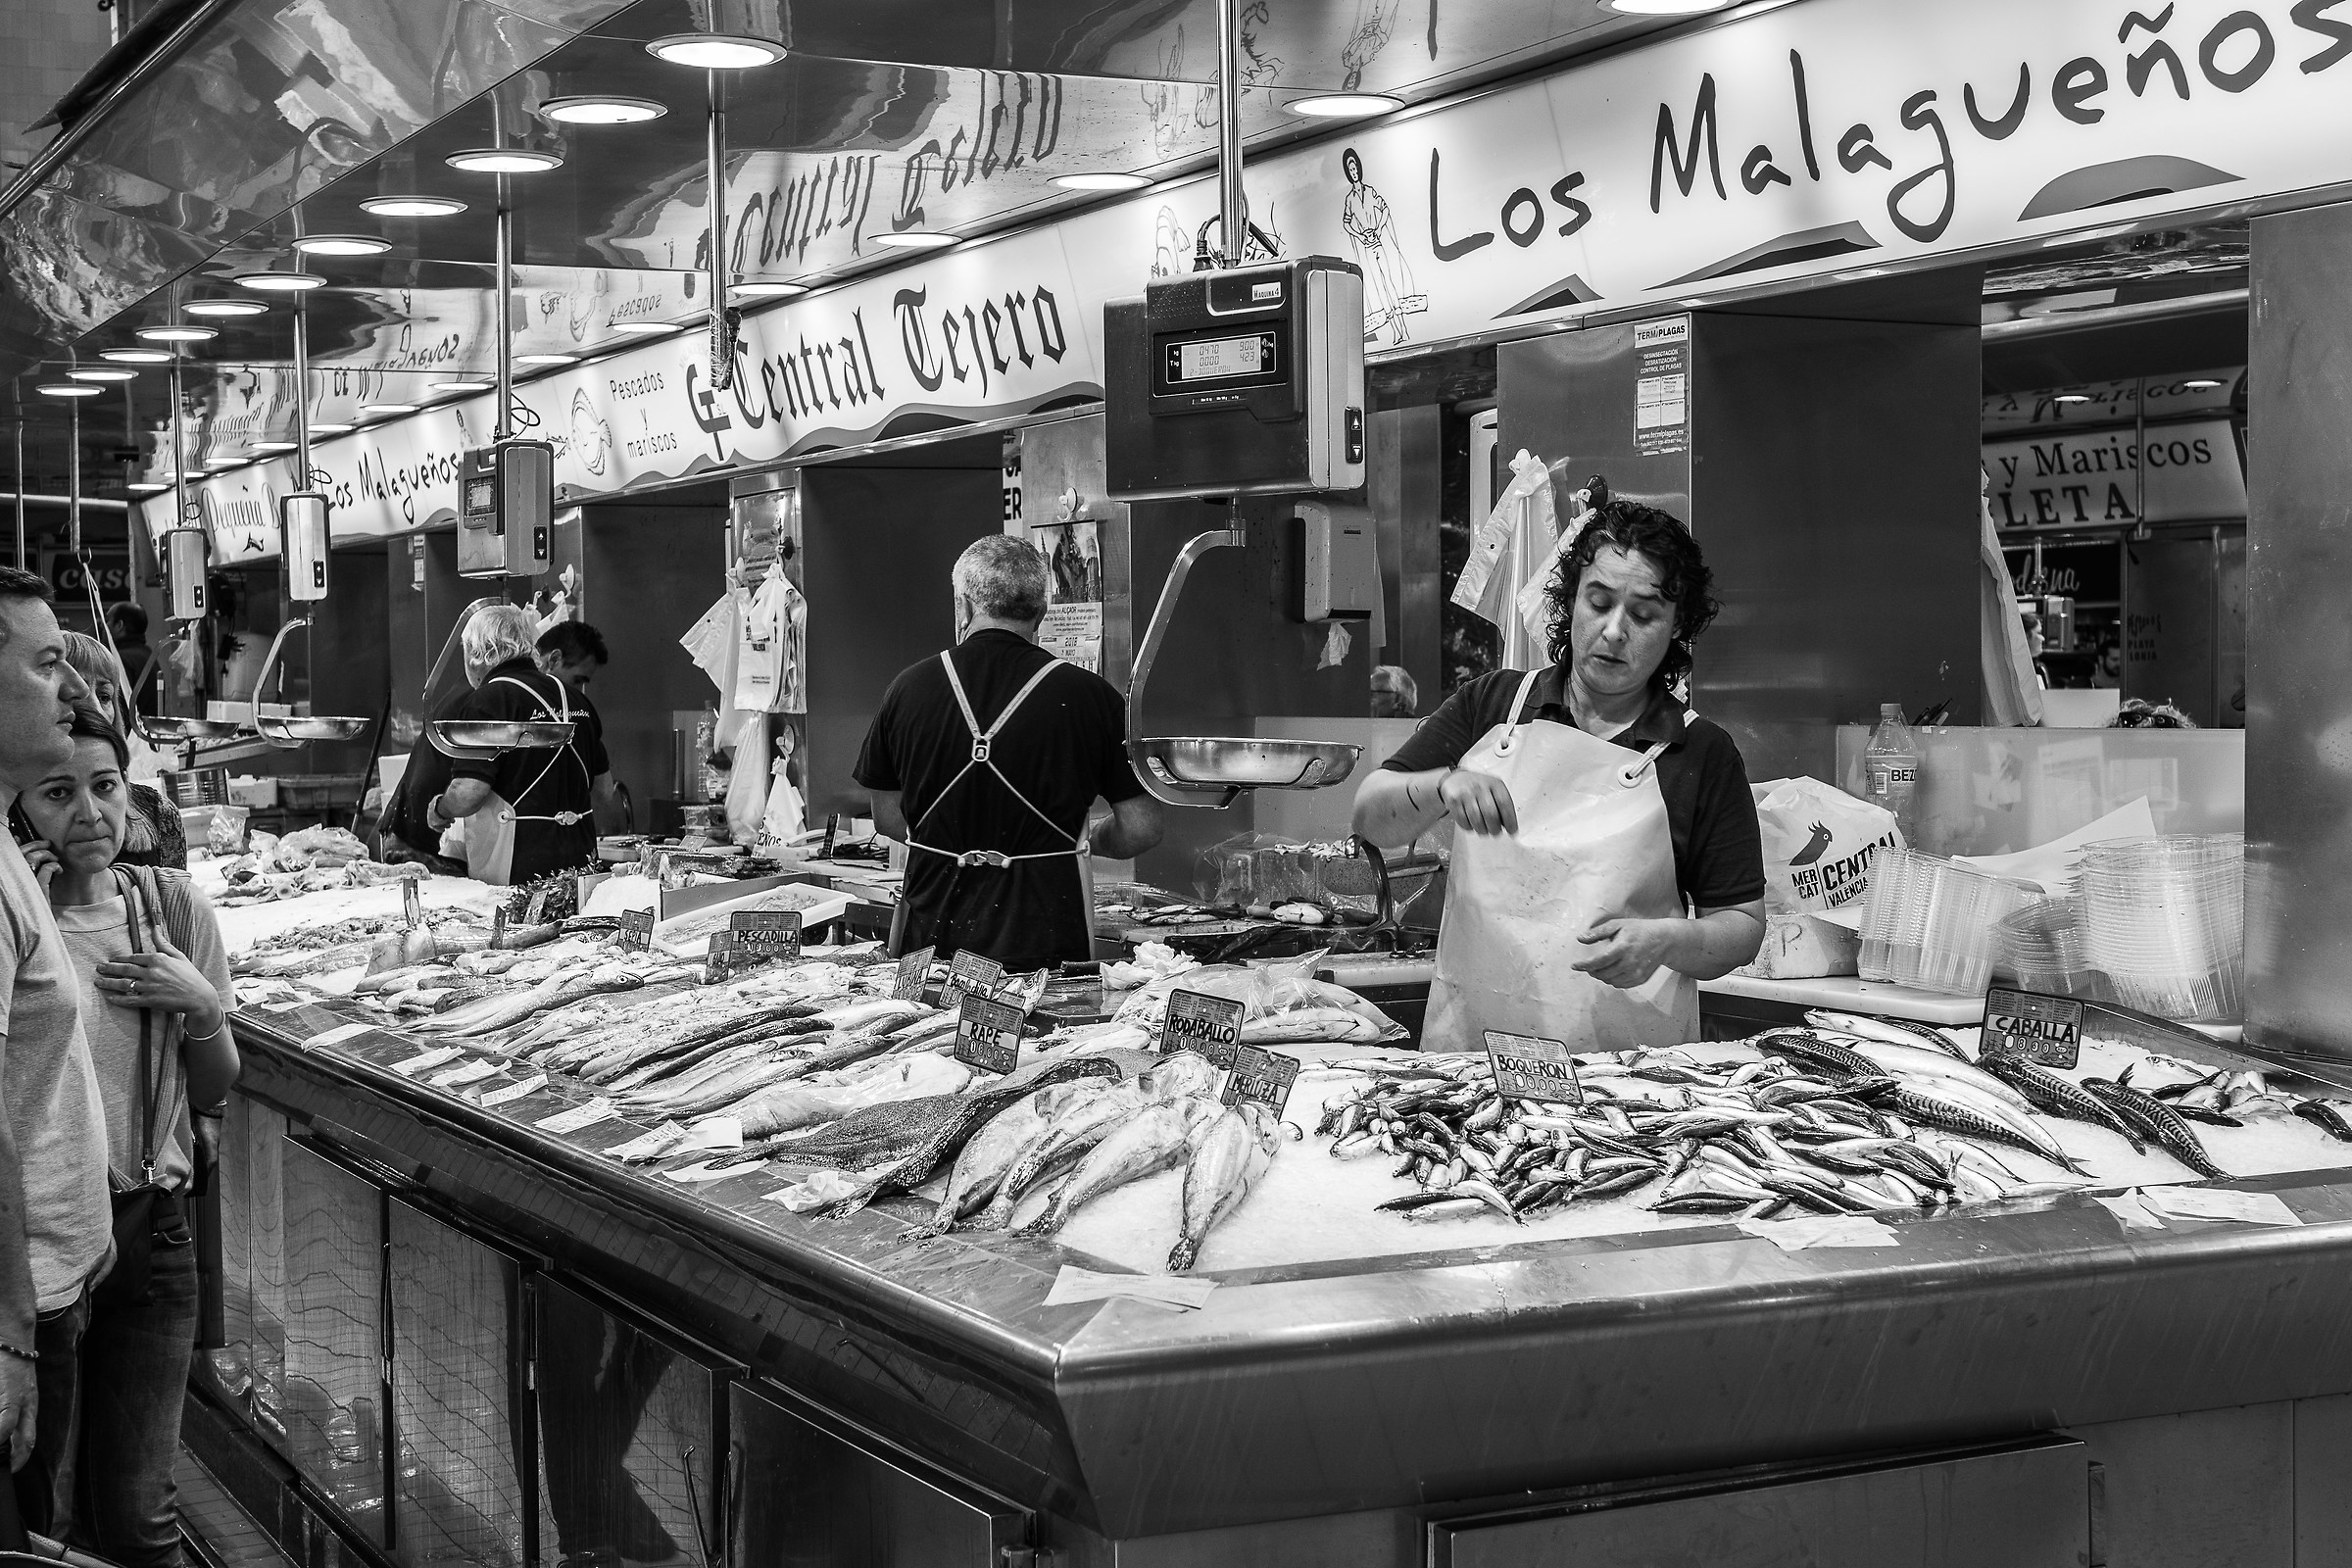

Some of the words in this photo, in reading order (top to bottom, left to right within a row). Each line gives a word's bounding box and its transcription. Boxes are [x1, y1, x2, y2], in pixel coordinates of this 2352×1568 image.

[1430, 148, 1592, 262] Los
[1650, 0, 2352, 243] Malagueños
[733, 306, 885, 430] Central
[894, 282, 1068, 398] Tejero
[610, 369, 664, 402] Pescados
[640, 408, 648, 431] y
[627, 432, 677, 458] mariscos
[1999, 454, 2019, 488] y
[2030, 435, 2212, 478] Mariscos
[358, 446, 459, 525] Malagueños
[1791, 868, 1818, 888] MER
[1798, 882, 1820, 900] CAT
[738, 930, 799, 945] PESCADILLA
[969, 1022, 1002, 1045] RAPE
[1168, 1014, 1236, 1044] RODABALLO
[1995, 1016, 2074, 1045] CABALLA
[1496, 1054, 1568, 1080] BOQUERON
